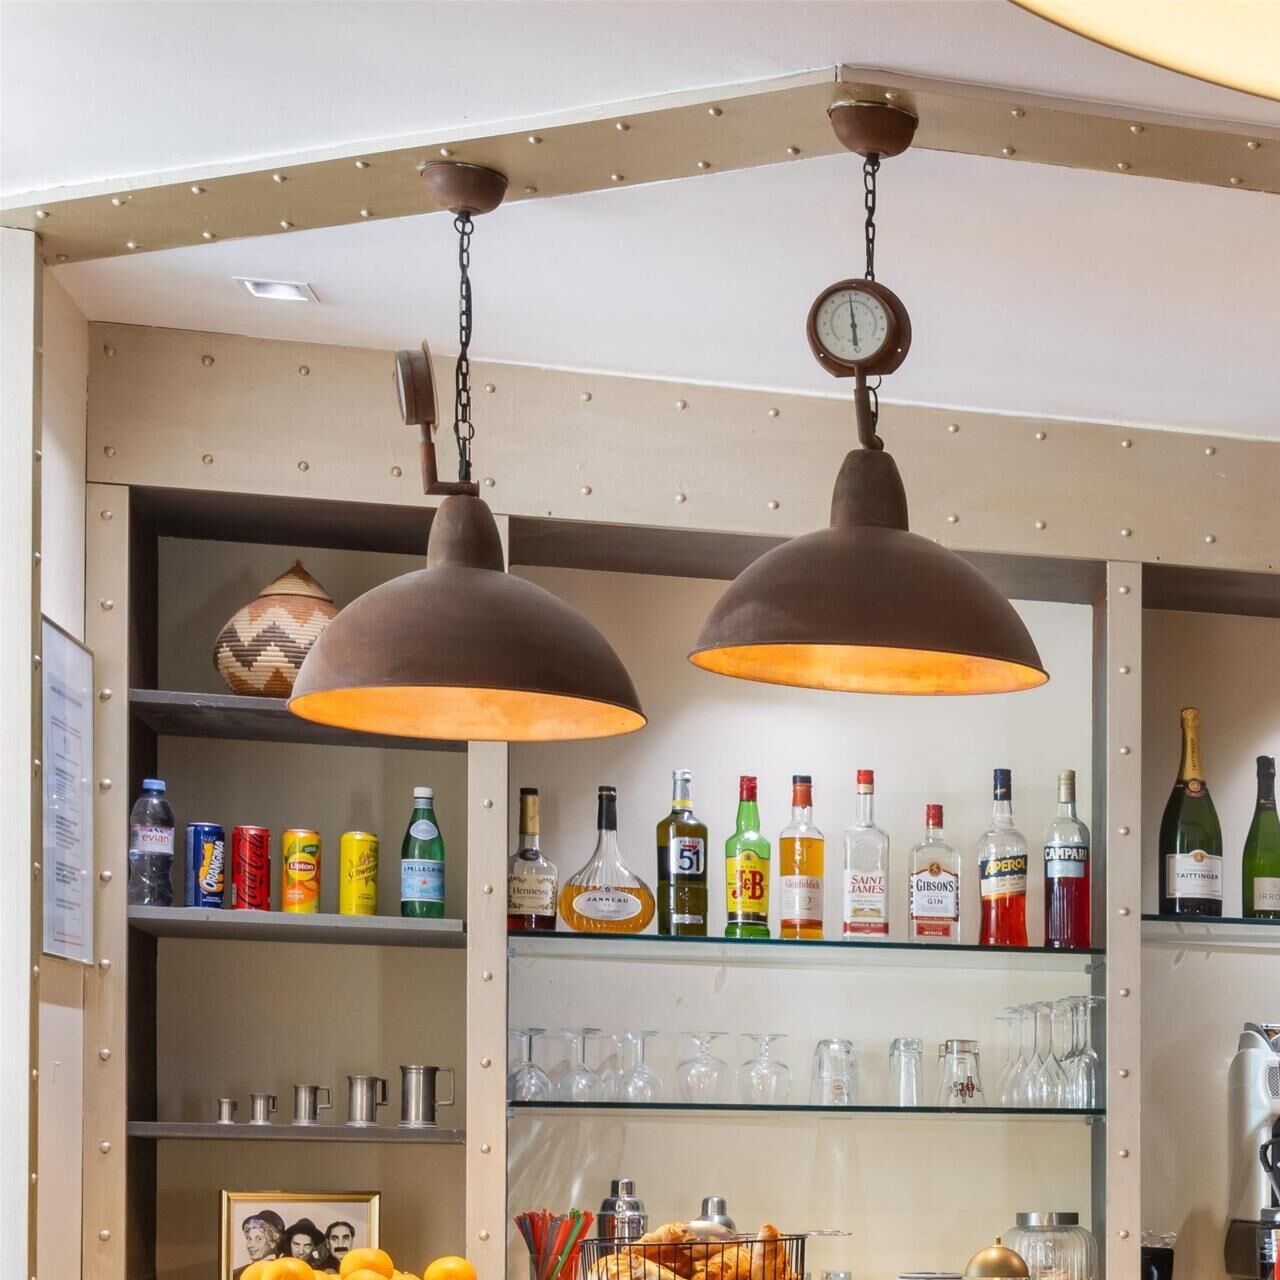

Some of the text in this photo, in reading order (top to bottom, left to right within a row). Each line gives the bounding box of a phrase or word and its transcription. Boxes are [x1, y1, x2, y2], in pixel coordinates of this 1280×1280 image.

[142, 834, 169, 844] evian
[1044, 847, 1088, 860] CAMPARI
[203, 840, 225, 891] ORANGINA
[678, 848, 700, 872] 51
[290, 861, 314, 871] Lipton
[984, 857, 1026, 876] APEROL
[850, 874, 885, 885] SAINT
[1175, 872, 1219, 880] TAITTINGER
[731, 869, 765, 900] J&B
[848, 884, 885, 894] JAMES
[512, 886, 549, 897] Hennessy
[585, 896, 630, 905] JANNEAU
